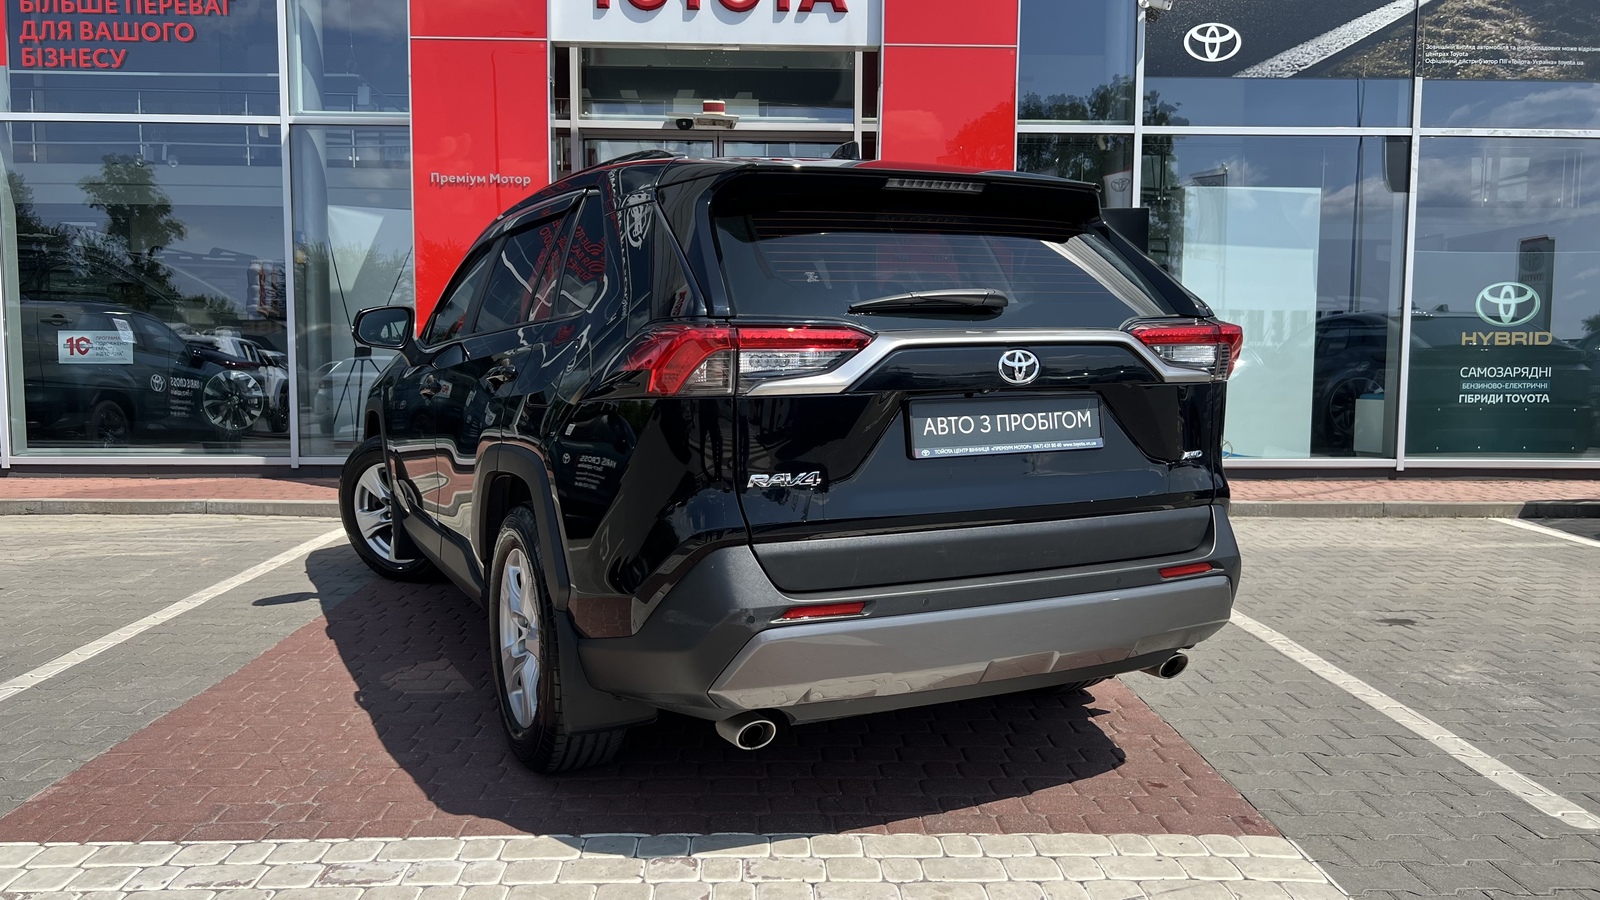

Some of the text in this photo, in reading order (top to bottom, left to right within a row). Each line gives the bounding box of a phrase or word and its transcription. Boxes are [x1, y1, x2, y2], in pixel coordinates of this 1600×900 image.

[20, 0, 118, 13] БІЛЬШЕ
[19, 20, 195, 44] ДЛЯ ВАШОГО
[1425, 43, 1455, 51] Зовнішній
[21, 47, 126, 68] БІЗНЕСУ
[1558, 59, 1584, 67] toyota.ua
[430, 172, 531, 187] Преміум Мотор
[1461, 331, 1553, 346] HYBRID
[1460, 366, 1552, 379] САМОЗАРЯДНІ
[1458, 394, 1550, 404] ГІБРИДИ TOYOTA
[923, 410, 1092, 436] АВТО З ПРОБІГОМ
[746, 470, 822, 488] RAV4
